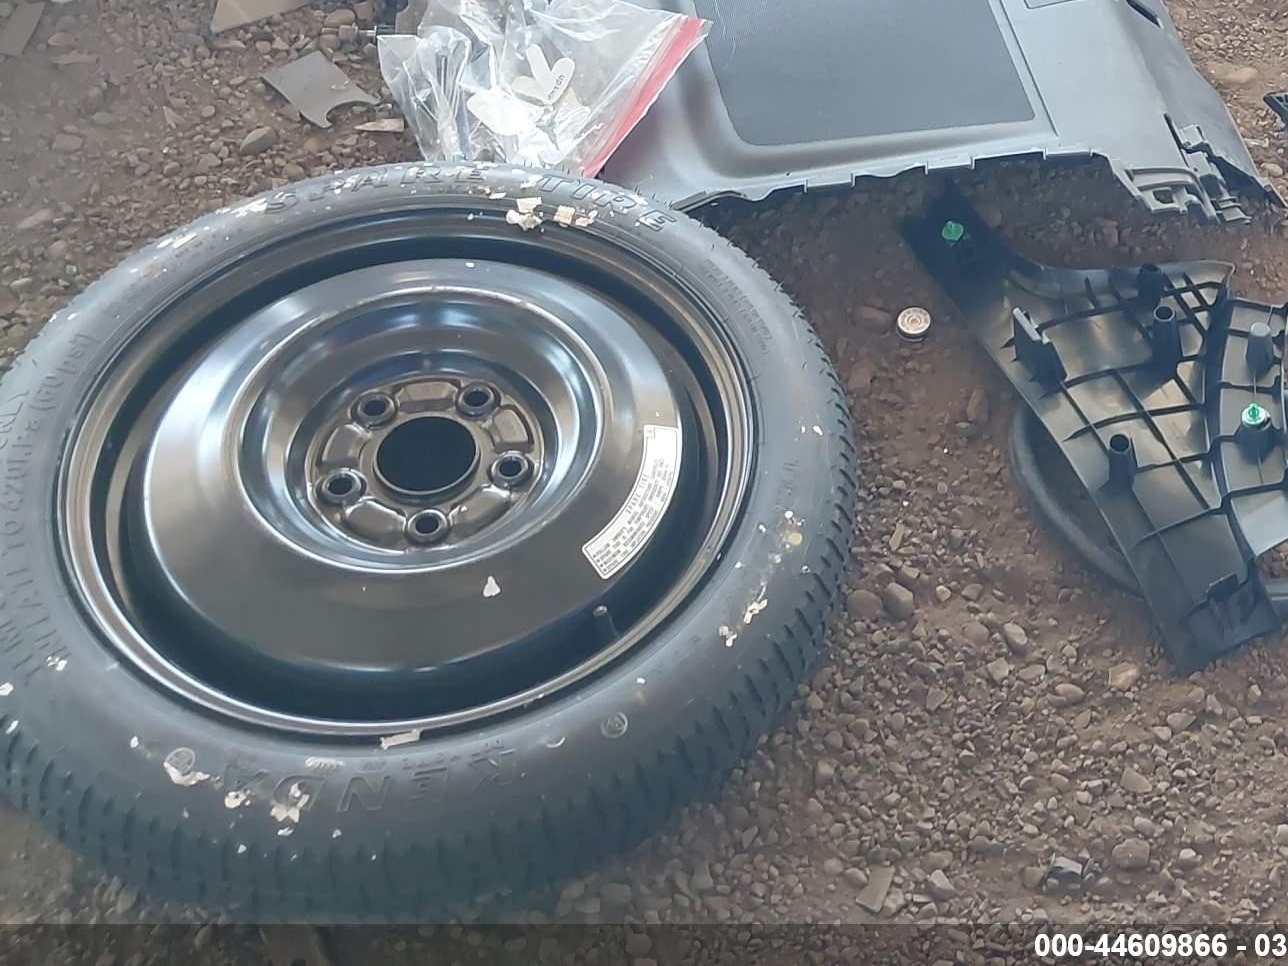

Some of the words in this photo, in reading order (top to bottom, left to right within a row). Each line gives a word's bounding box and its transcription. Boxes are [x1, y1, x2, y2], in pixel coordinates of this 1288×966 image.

[262, 162, 488, 214] SPARE
[537, 173, 676, 232] TIRE
[222, 746, 515, 813] KENDA
